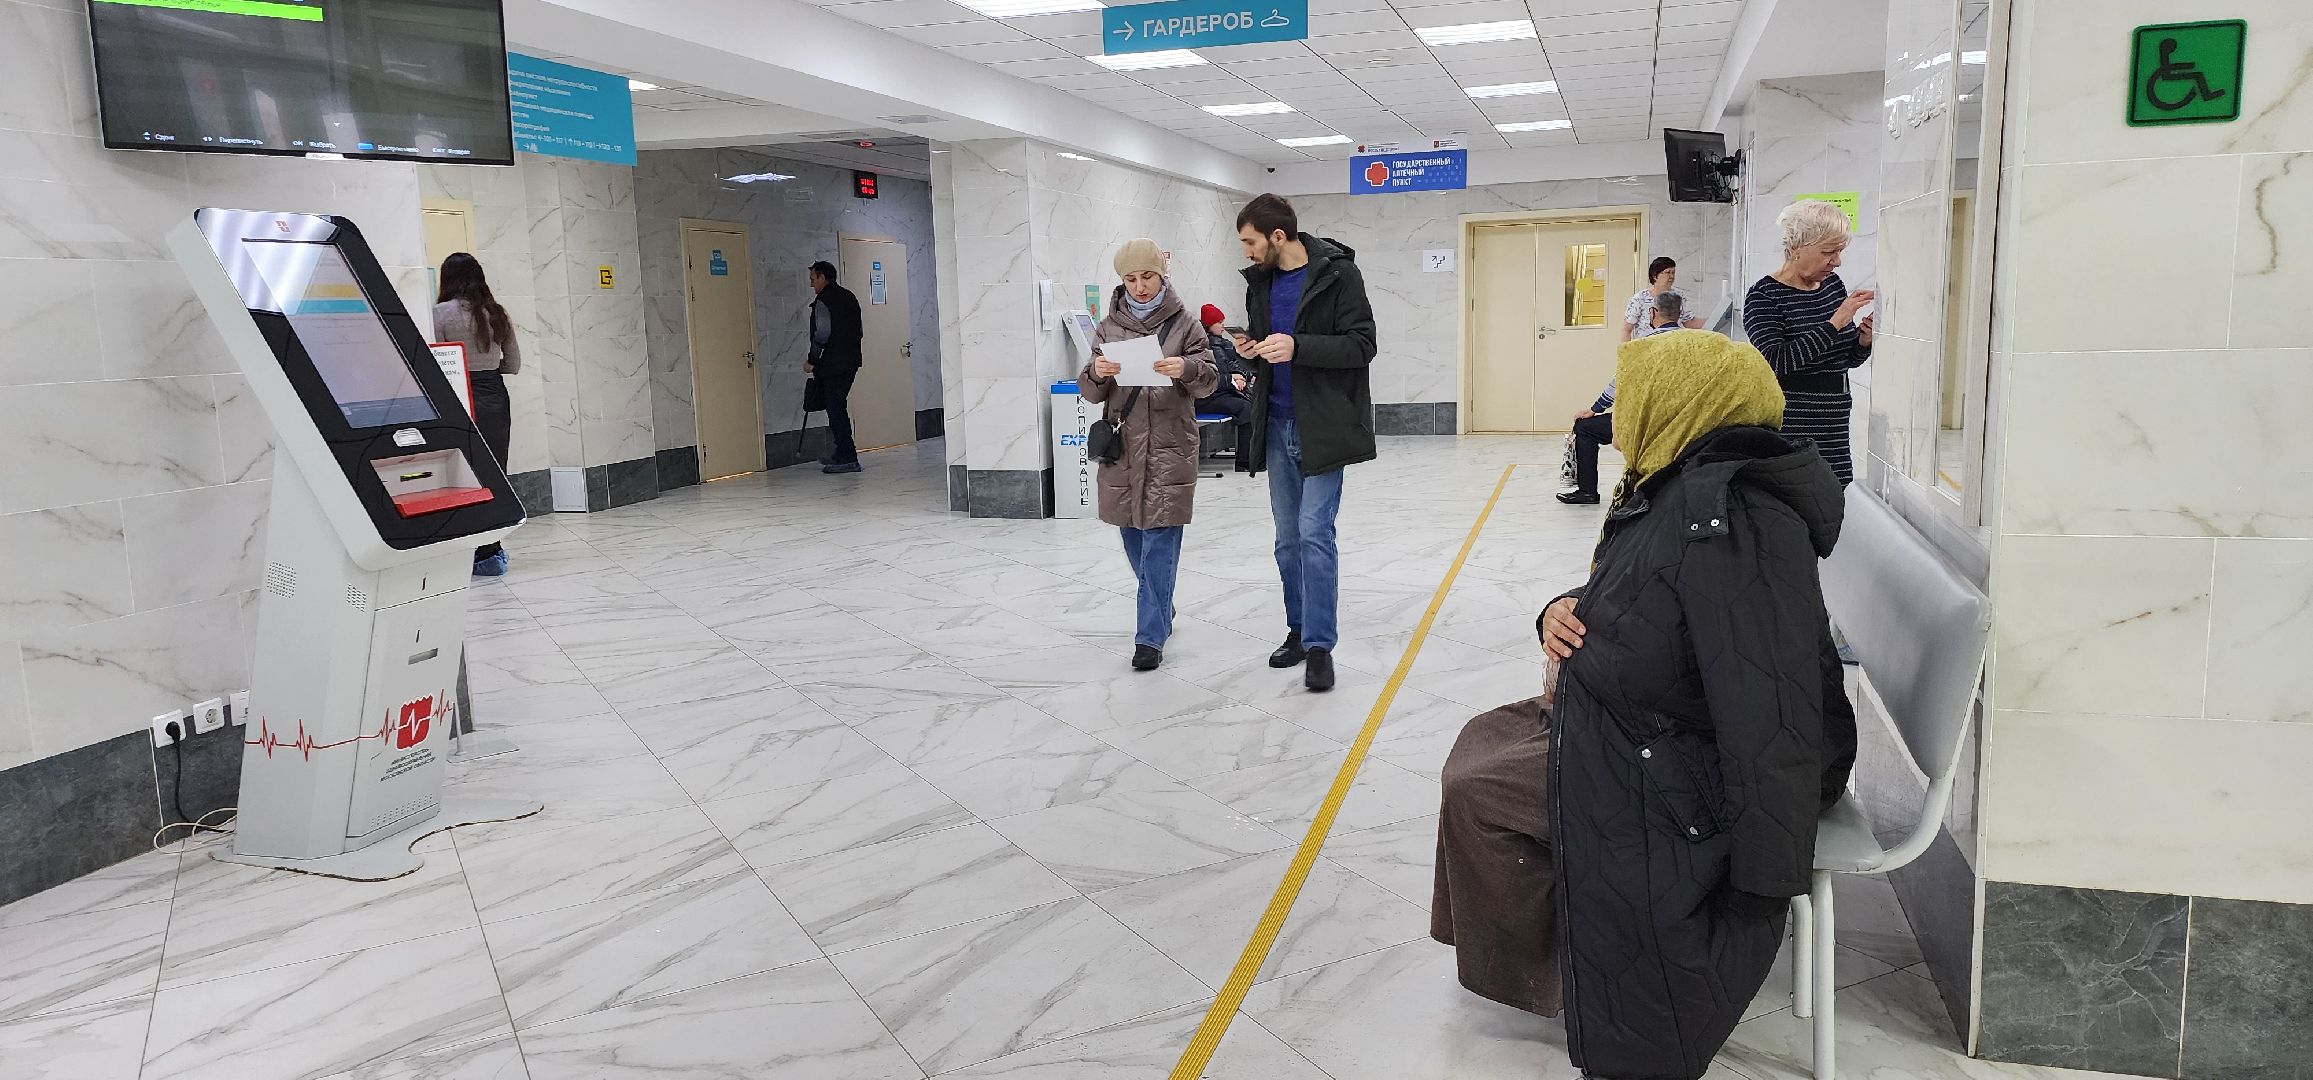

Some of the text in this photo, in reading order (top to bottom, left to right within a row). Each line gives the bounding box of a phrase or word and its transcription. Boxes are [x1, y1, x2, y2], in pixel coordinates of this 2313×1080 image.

[1143, 12, 1254, 38] ГАРДЕРОБ
[1392, 157, 1451, 169] ГОСУДАРСТВЕННЫЙ
[1392, 167, 1425, 178] АПТЕЧНЫЙ
[1392, 178, 1412, 187] ПУНКТ
